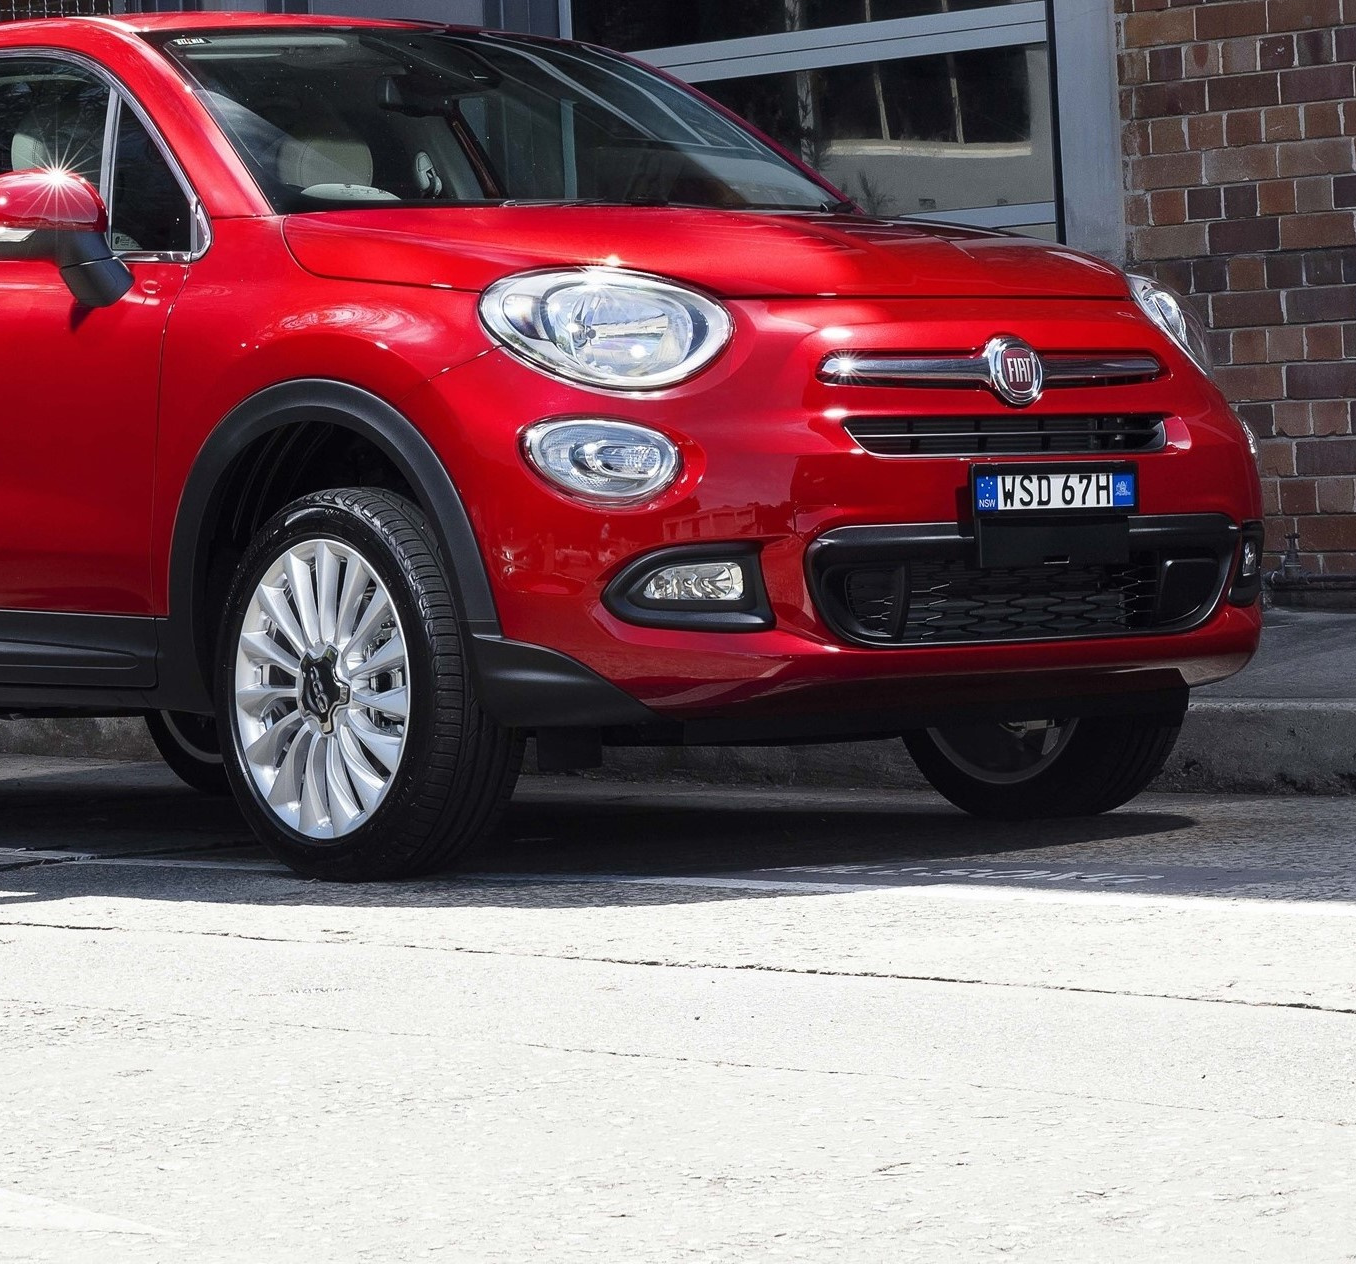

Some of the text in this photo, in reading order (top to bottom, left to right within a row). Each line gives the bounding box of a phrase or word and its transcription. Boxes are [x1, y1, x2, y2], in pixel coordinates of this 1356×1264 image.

[1006, 357, 1032, 383] FIAT
[978, 499, 996, 508] NSW
[1001, 473, 1111, 508] WSD 67H
